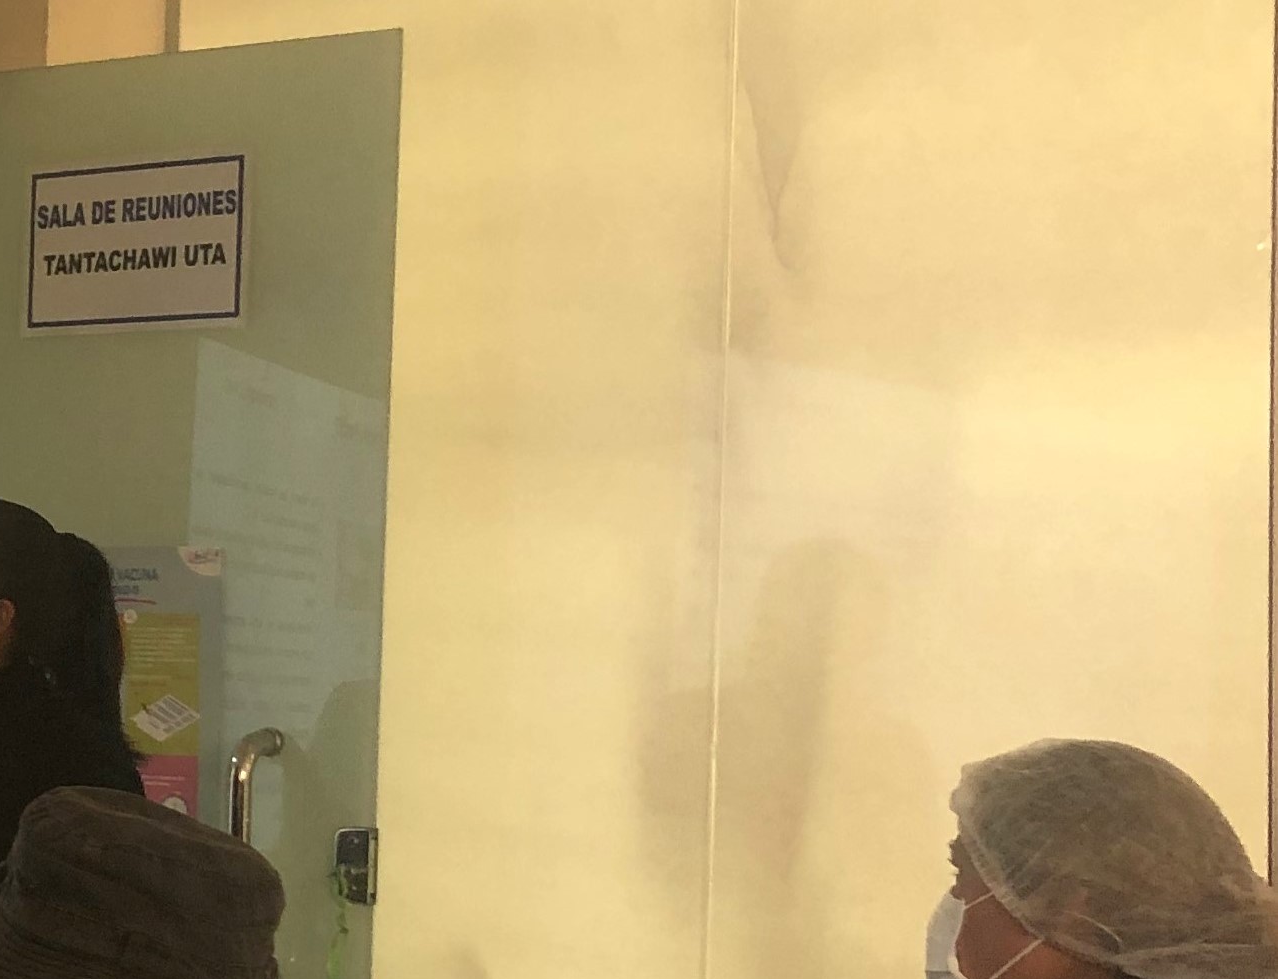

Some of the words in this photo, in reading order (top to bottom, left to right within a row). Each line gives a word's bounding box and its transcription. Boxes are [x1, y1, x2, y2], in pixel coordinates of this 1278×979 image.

[37, 203, 85, 229] SALA
[92, 200, 116, 224] DE
[122, 190, 237, 222] REUNIONES
[44, 246, 176, 276] TANTACHAWI
[184, 243, 226, 266] UTA
